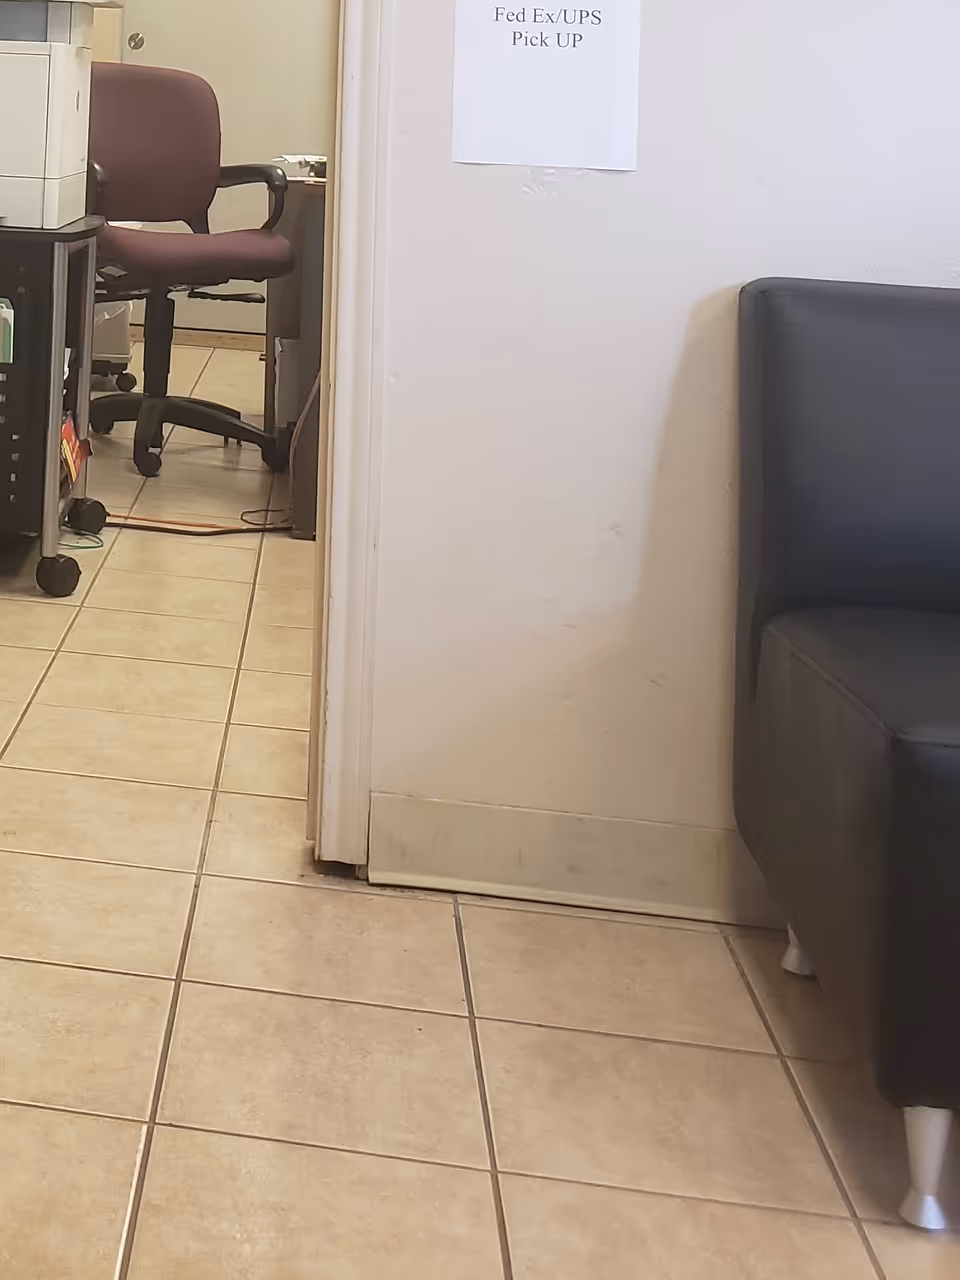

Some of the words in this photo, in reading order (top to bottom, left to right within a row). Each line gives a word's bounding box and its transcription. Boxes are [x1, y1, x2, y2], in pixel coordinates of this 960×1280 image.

[494, 7, 526, 23] Fed
[532, 8, 602, 25] Ex/UPS
[511, 31, 550, 47] Pick
[556, 32, 583, 48] UP
